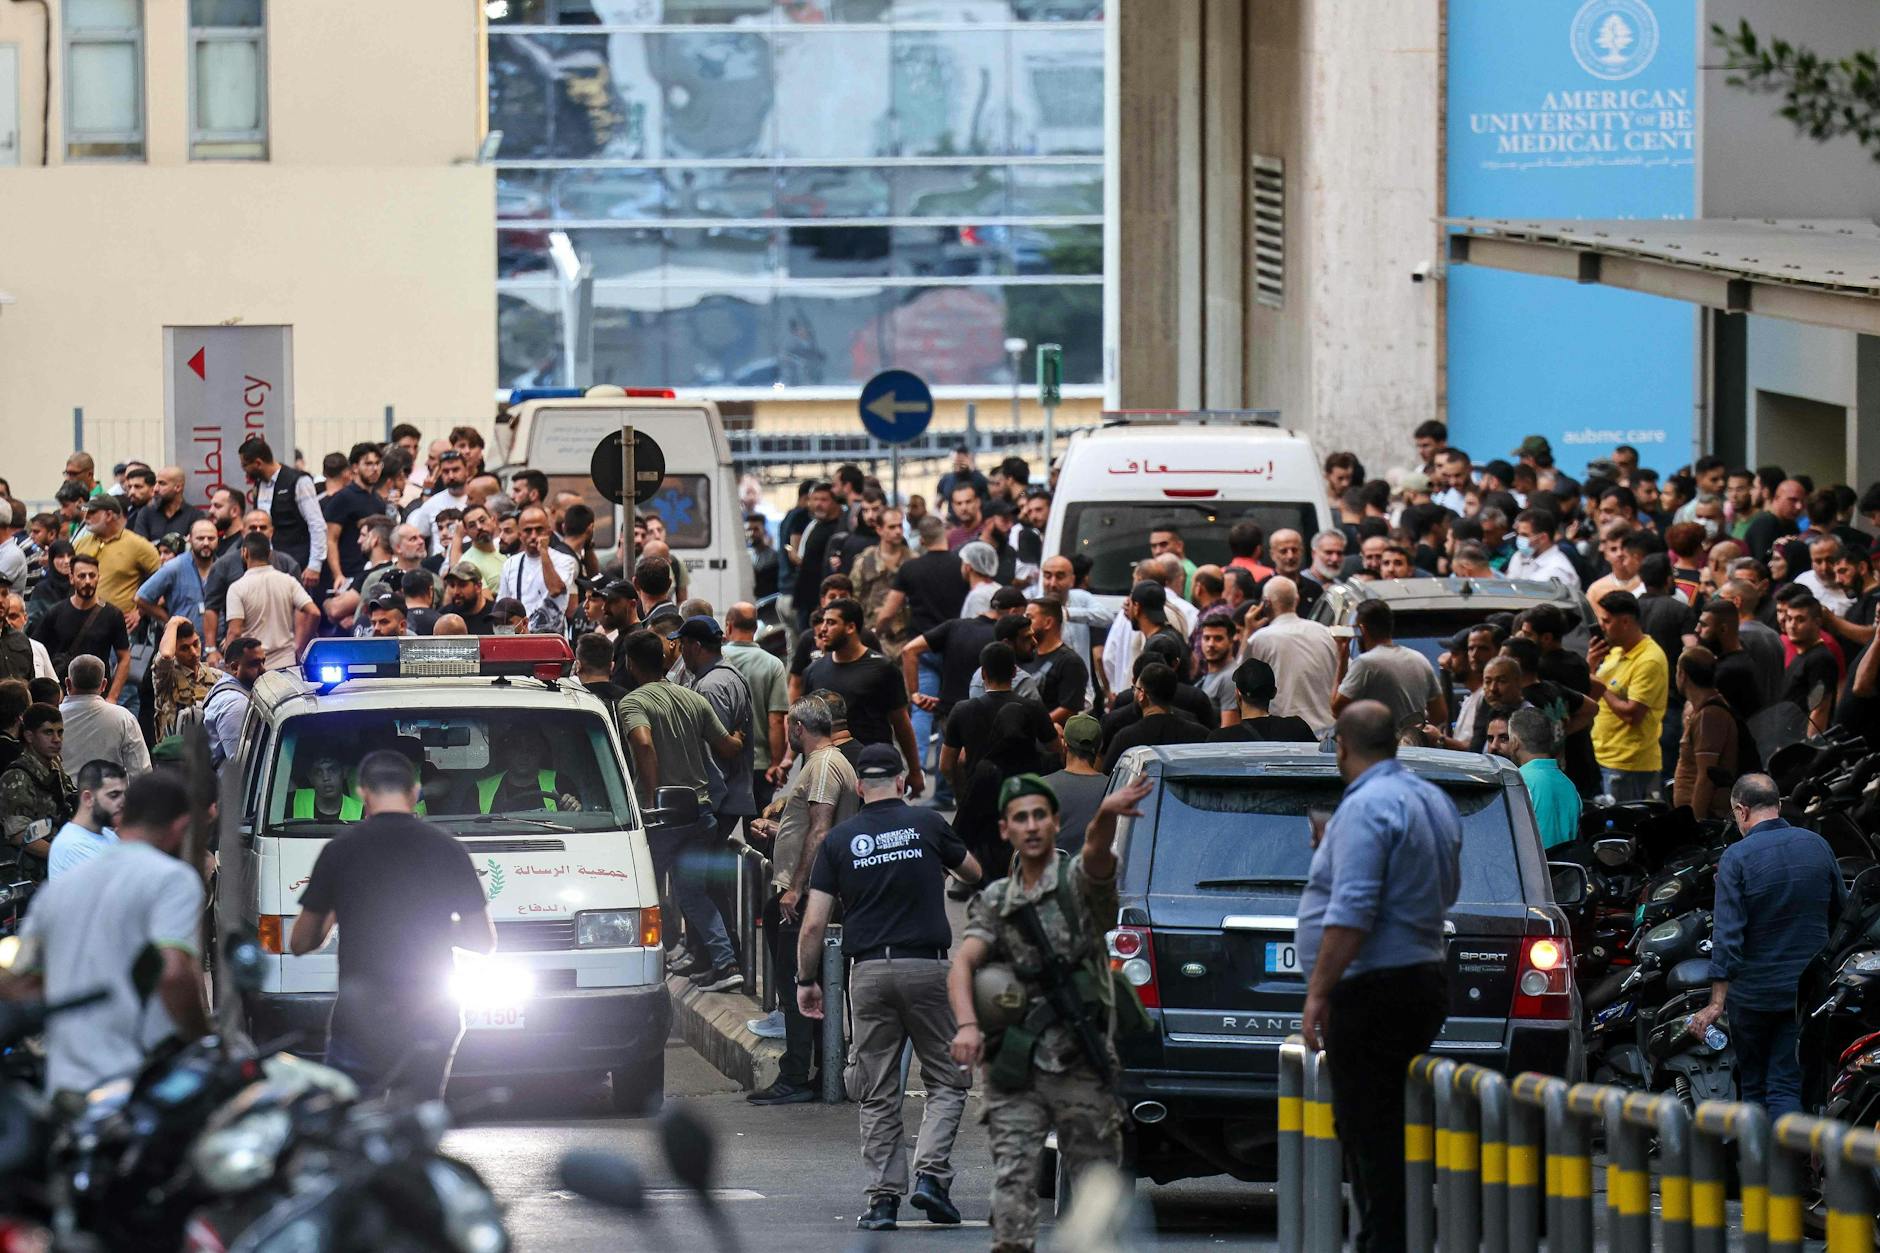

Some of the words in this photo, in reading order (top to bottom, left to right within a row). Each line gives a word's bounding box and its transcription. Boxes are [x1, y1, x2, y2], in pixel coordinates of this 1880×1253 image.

[1541, 88, 1688, 112] AMERICAN
[1469, 110, 1633, 134] UNIVERSITY
[1660, 109, 1696, 130] BE
[1497, 132, 1619, 154] MEDICAL
[1108, 458, 1274, 480] إسعاف
[876, 828, 915, 840] AMERICAN
[876, 833, 920, 845] UNIVERSITY
[883, 840, 909, 849] BEIRUT
[853, 849, 923, 869] PROTECTION
[513, 864, 570, 878] الرسالة
[1460, 951, 1508, 961] SPORT
